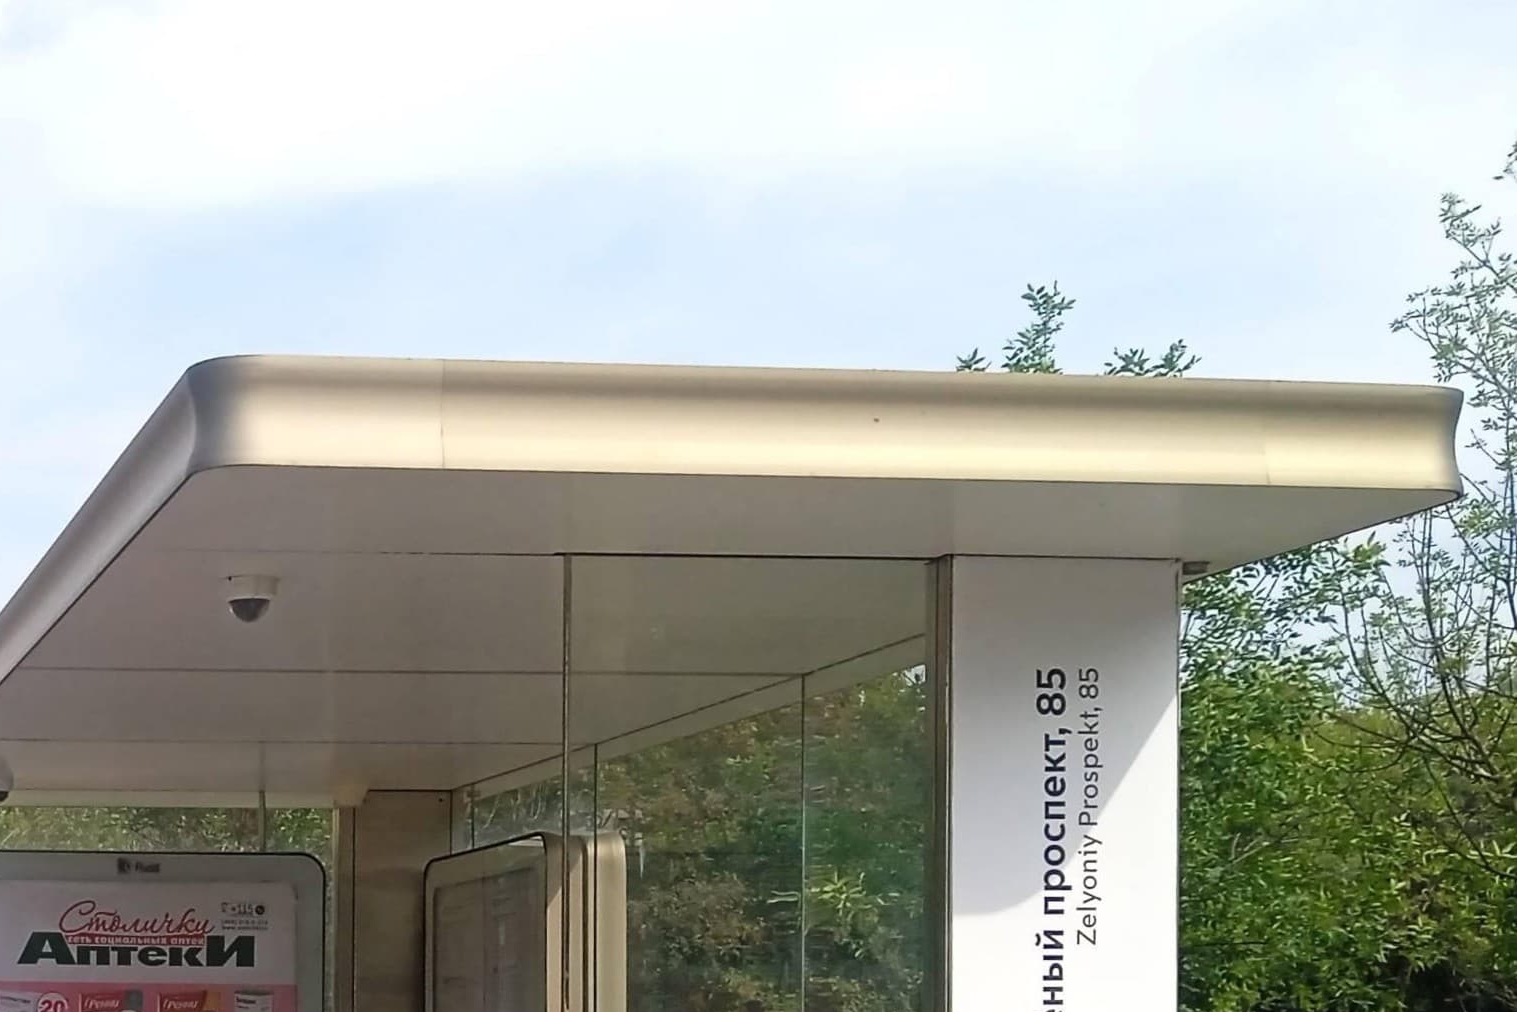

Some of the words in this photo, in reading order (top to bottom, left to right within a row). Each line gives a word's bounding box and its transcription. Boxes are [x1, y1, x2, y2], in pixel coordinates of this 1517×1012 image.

[1036, 668, 1067, 717] 85
[1078, 667, 1100, 700] 85
[1077, 706, 1105, 827] Prospekt,
[1042, 727, 1073, 916] проспект,
[58, 899, 216, 935] Столички
[1076, 833, 1103, 946] Zelyoniy
